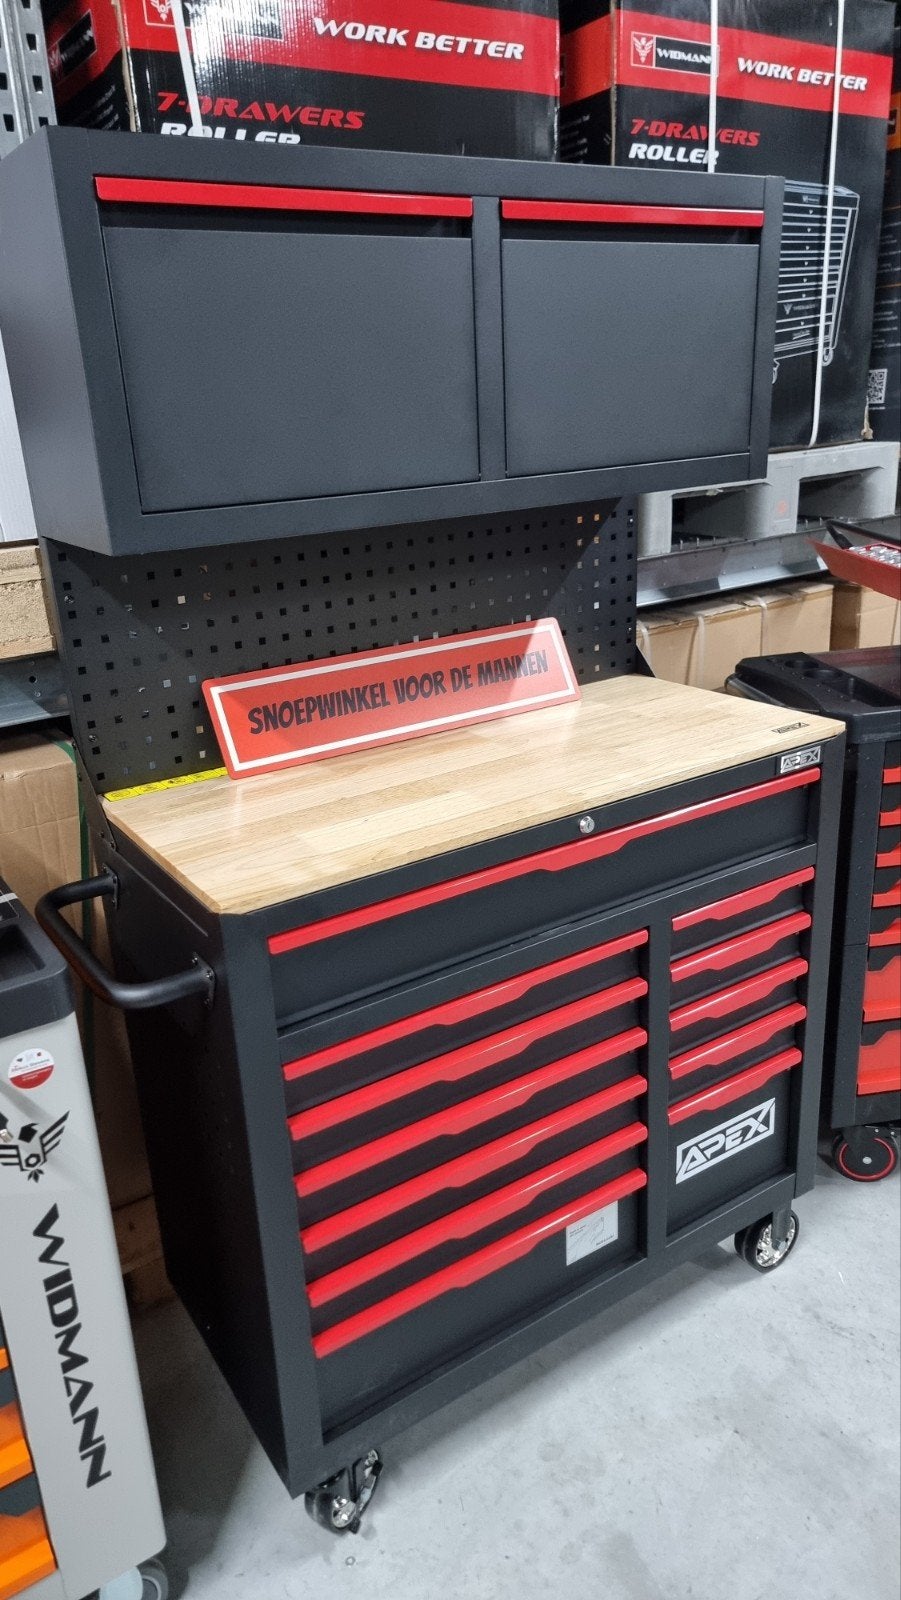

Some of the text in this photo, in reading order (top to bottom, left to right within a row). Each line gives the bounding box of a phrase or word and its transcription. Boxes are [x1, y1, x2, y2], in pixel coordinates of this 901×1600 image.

[313, 16, 525, 60] WORK BETTER
[737, 57, 794, 81] WORK
[248, 649, 550, 735] SNOEPWINKEL VOOR DE MANNEN
[781, 745, 821, 773] APEX
[676, 1097, 776, 1185] APEX
[32, 1202, 113, 1489] WIDMANN
